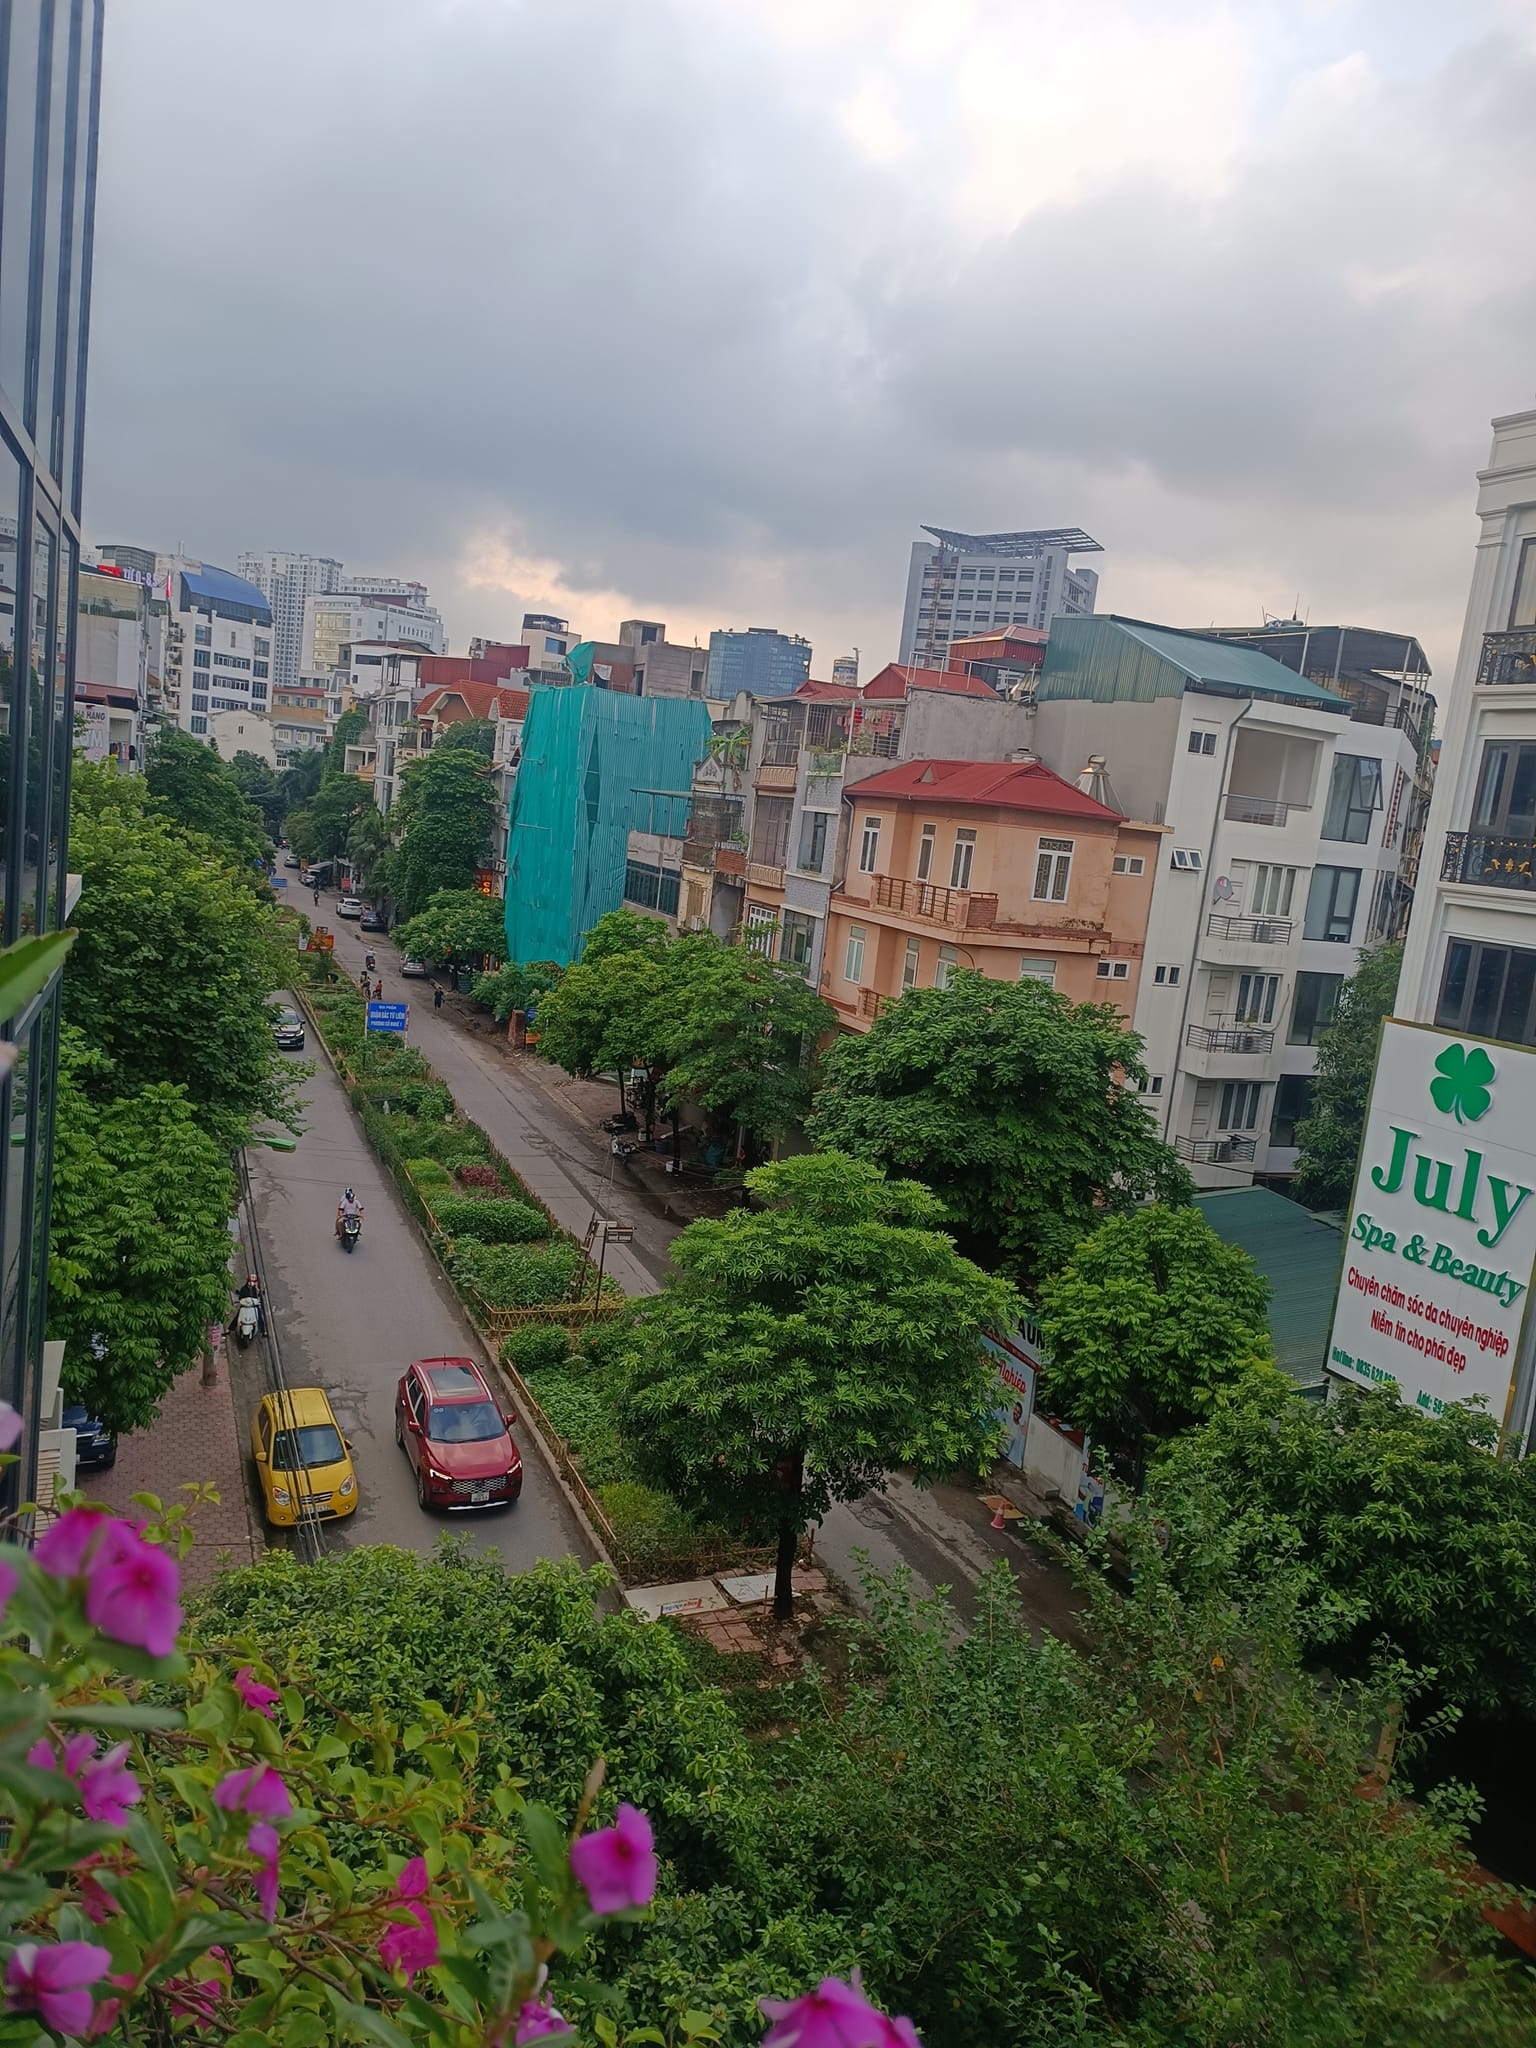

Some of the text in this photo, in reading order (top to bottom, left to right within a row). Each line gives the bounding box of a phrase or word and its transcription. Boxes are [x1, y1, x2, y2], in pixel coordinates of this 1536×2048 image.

[1370, 1125, 1535, 1249] July
[1351, 1213, 1527, 1308] Spa & Beauty
[1347, 1266, 1509, 1359] Chuyên chăm sóc da chuyên nghiệp
[1370, 1309, 1467, 1375] Niềm tin cho phái đẹp
